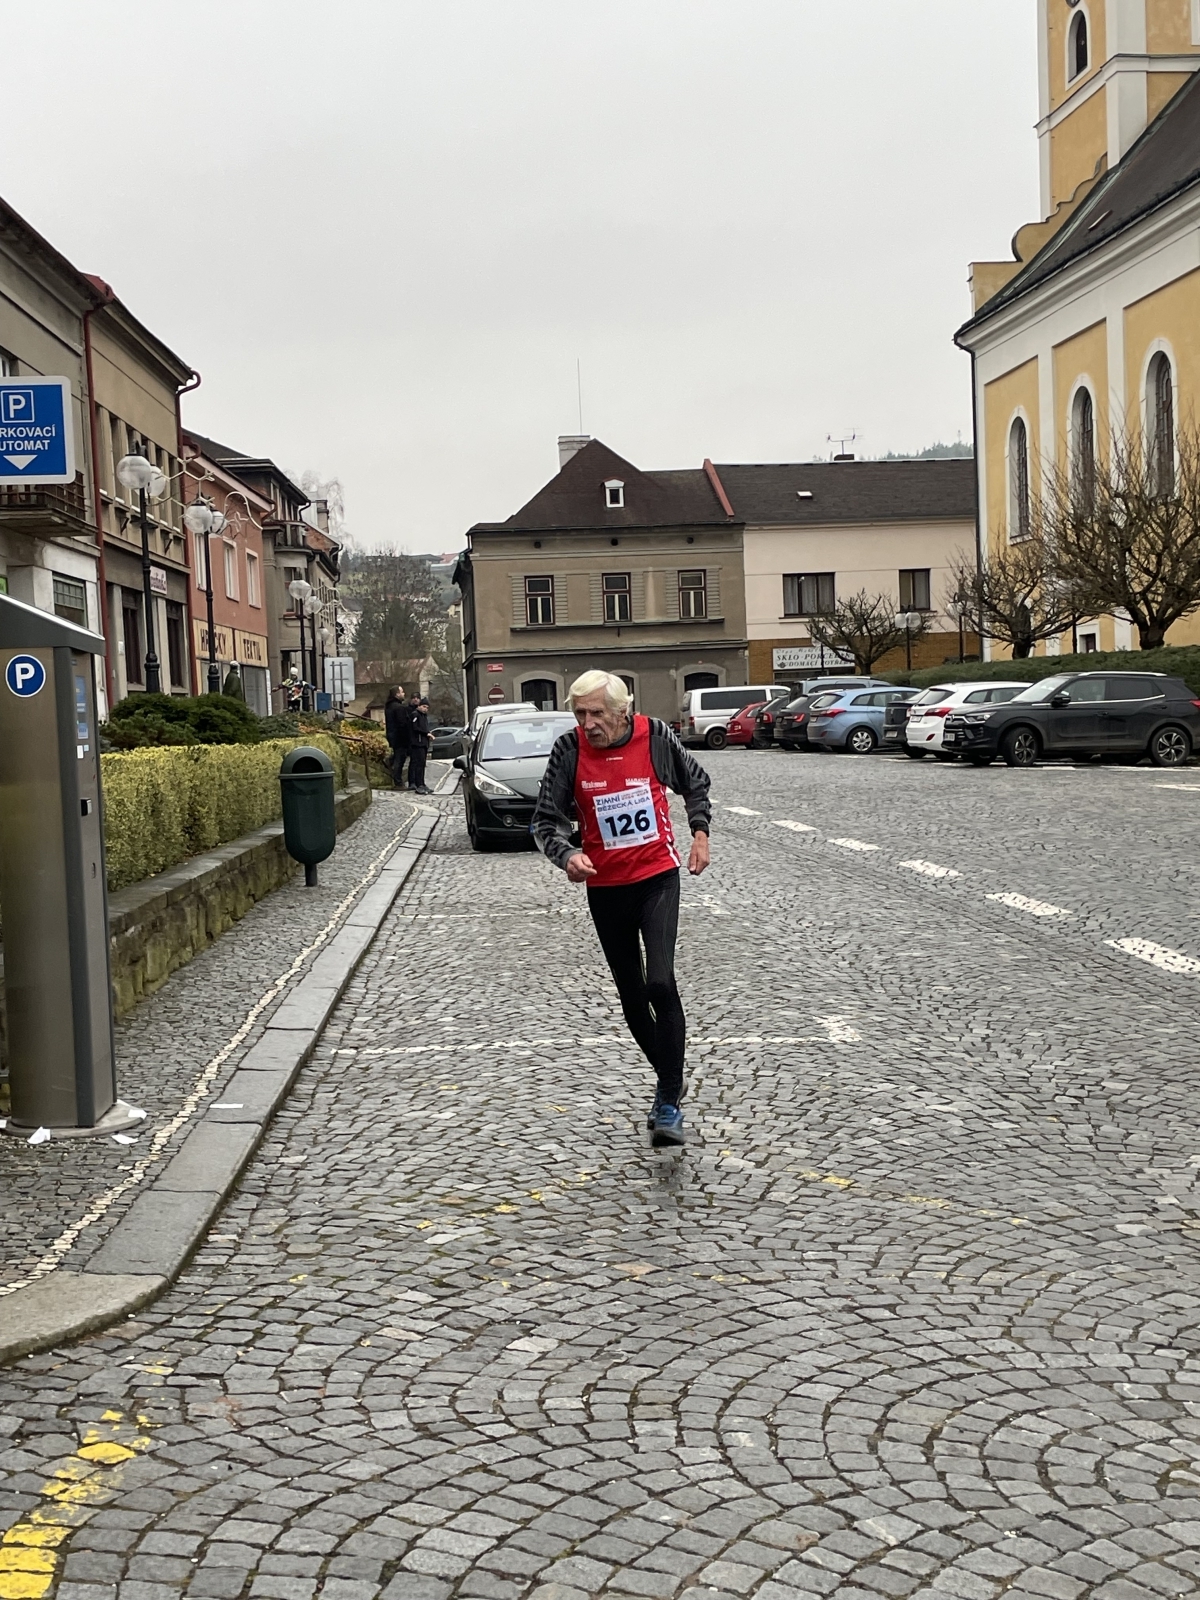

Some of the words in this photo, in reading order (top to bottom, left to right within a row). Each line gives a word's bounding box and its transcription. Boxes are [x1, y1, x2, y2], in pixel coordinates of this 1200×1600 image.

[9, 395, 26, 418] P
[0, 424, 56, 438] RKOVACÍ
[0, 440, 50, 451] UTOMAT
[243, 638, 262, 661] TEXTIL
[596, 794, 620, 806] ZIMNÍ
[634, 796, 651, 805] LIGA
[604, 809, 651, 838] 126
